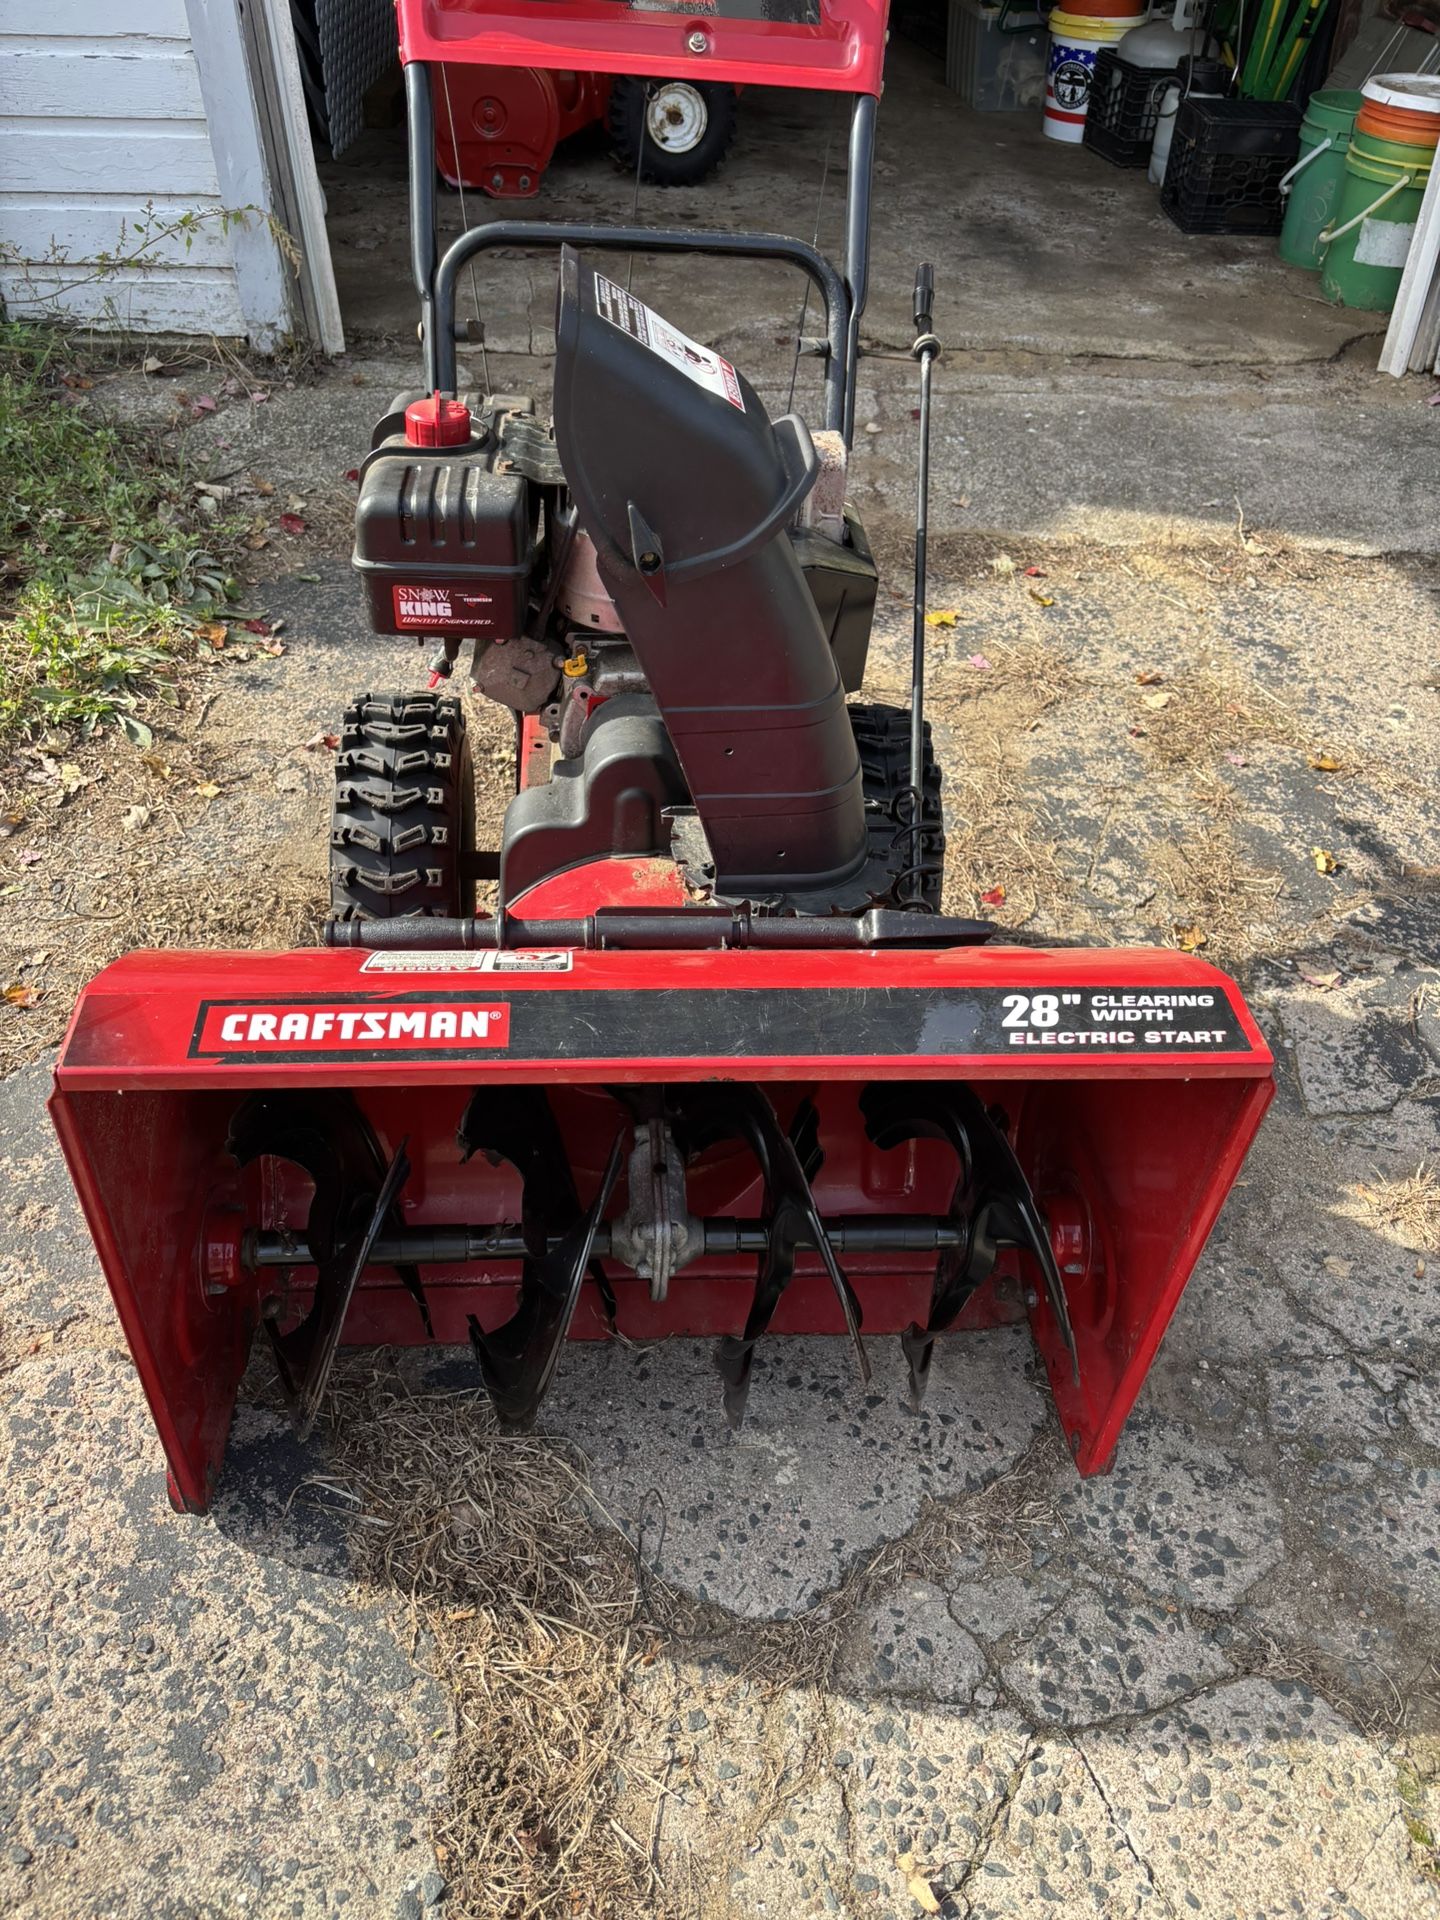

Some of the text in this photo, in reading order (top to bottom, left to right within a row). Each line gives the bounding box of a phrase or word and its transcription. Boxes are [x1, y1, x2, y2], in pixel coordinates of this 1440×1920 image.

[400, 601, 452, 617] KING
[1091, 995, 1214, 1007] CLEARING
[1001, 993, 1081, 1027] 28"
[1091, 1009, 1174, 1021] WIDTH
[1009, 1030, 1227, 1045] ELECTRIC START
